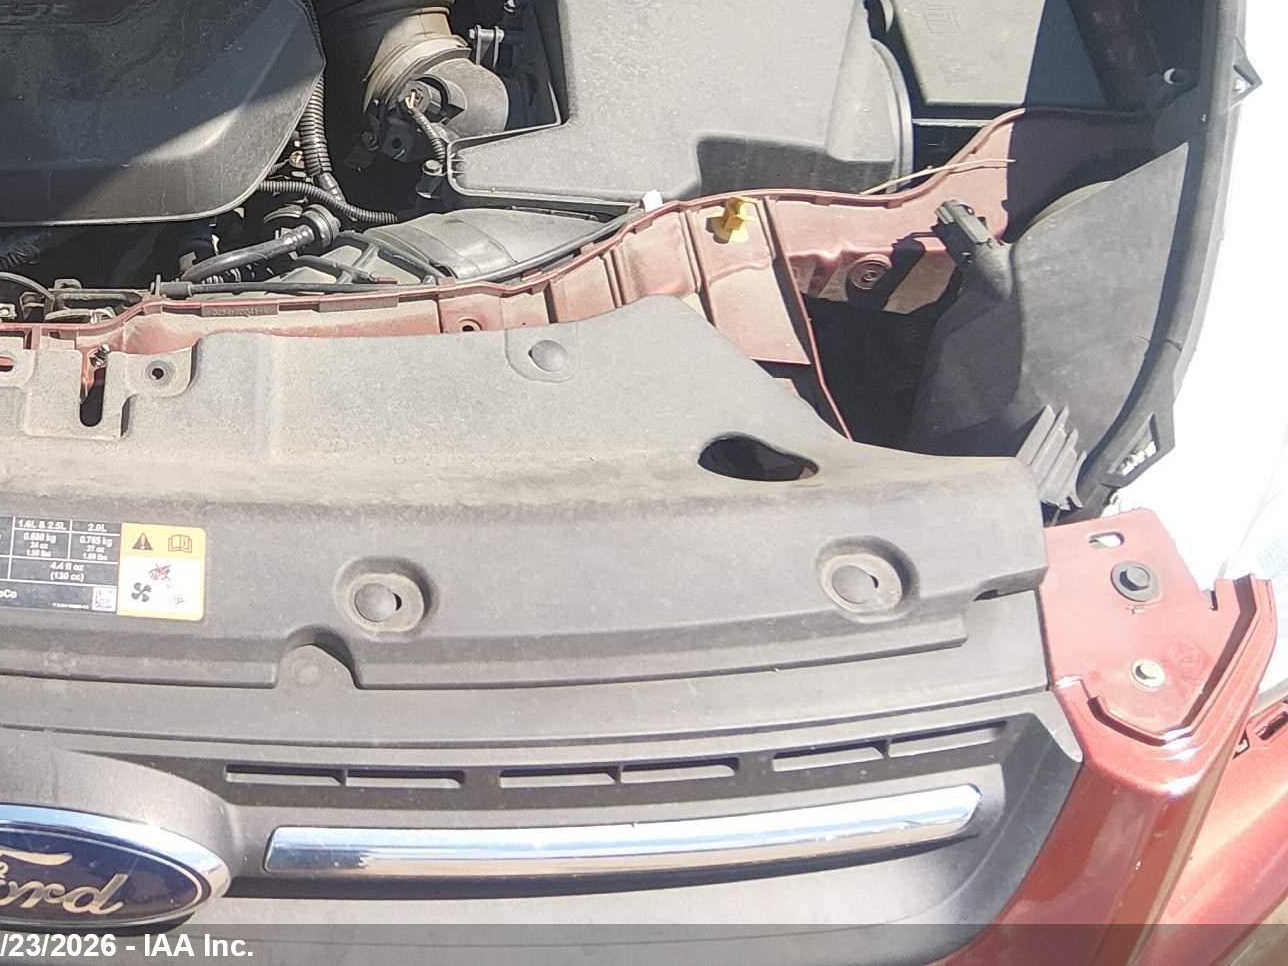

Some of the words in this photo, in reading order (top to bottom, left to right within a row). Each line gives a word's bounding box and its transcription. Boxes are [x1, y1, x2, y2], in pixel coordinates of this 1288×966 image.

[47, 521, 66, 530] 2.5L
[87, 523, 107, 532] 2.0L
[45, 533, 57, 544] kg
[101, 537, 112, 547] kg
[69, 572, 85, 582] cc)
